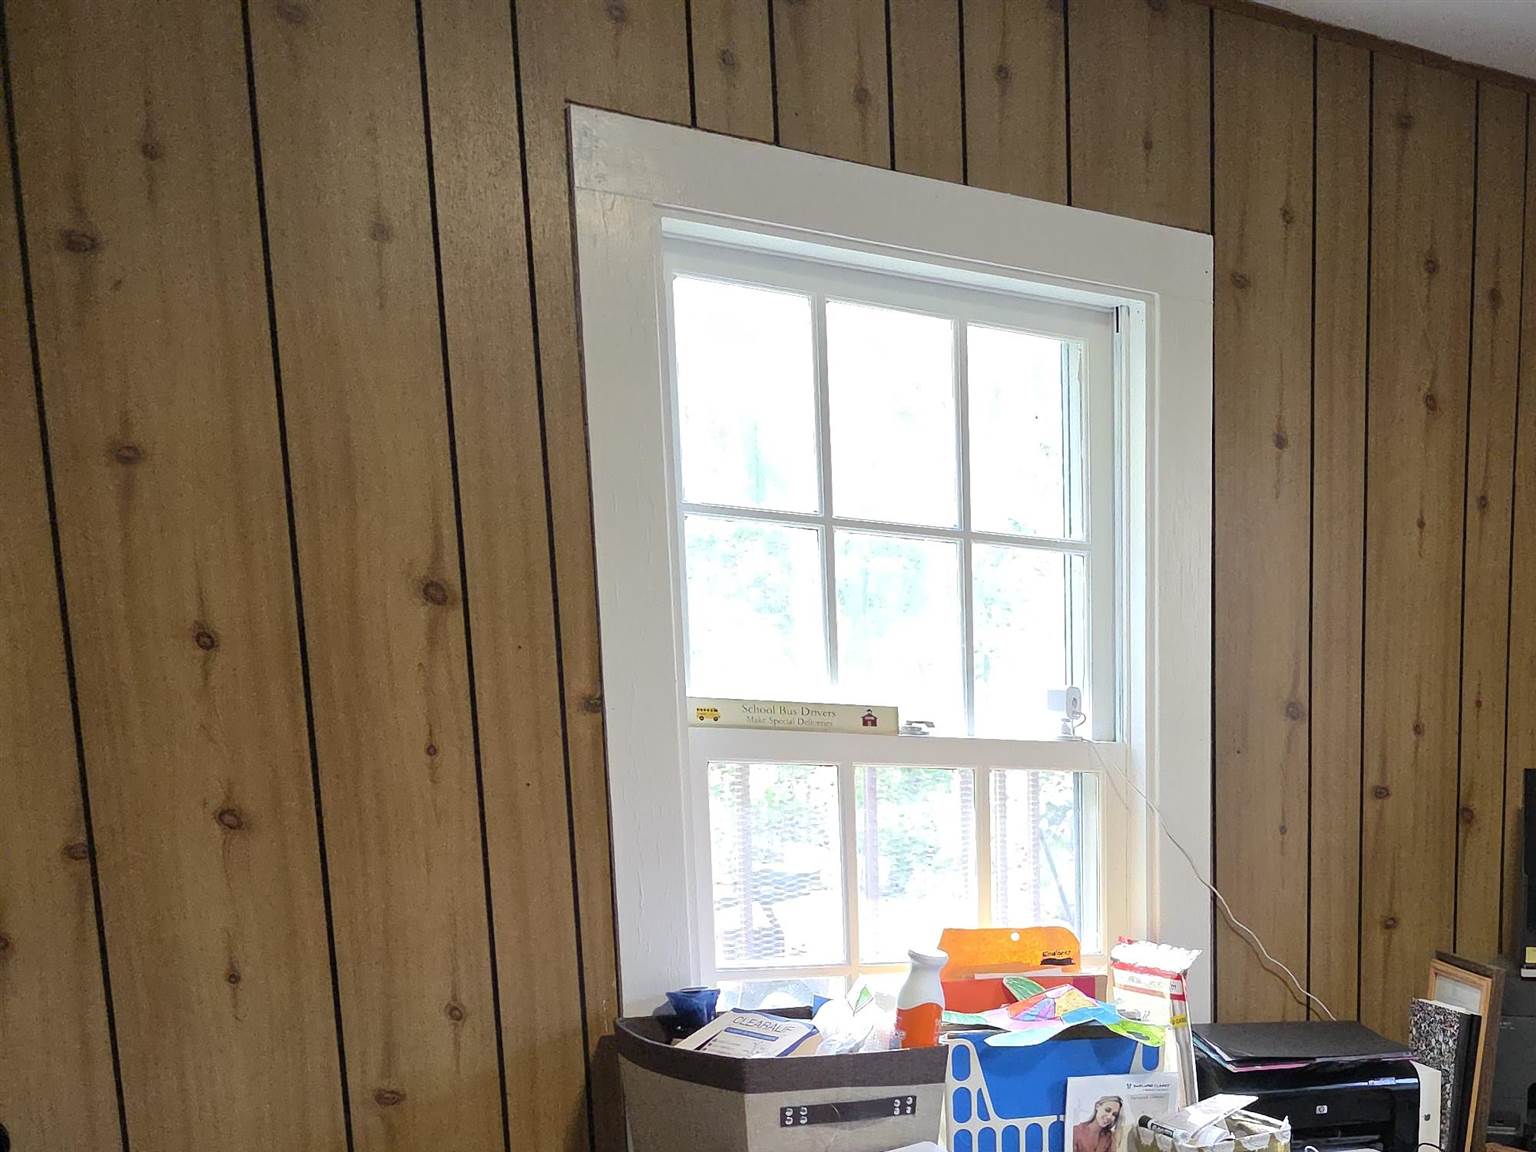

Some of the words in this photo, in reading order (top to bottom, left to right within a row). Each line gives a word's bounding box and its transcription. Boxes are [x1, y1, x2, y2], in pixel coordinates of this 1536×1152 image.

[742, 703, 776, 715] School
[779, 705, 797, 716] Bus
[801, 706, 836, 717] Drivers
